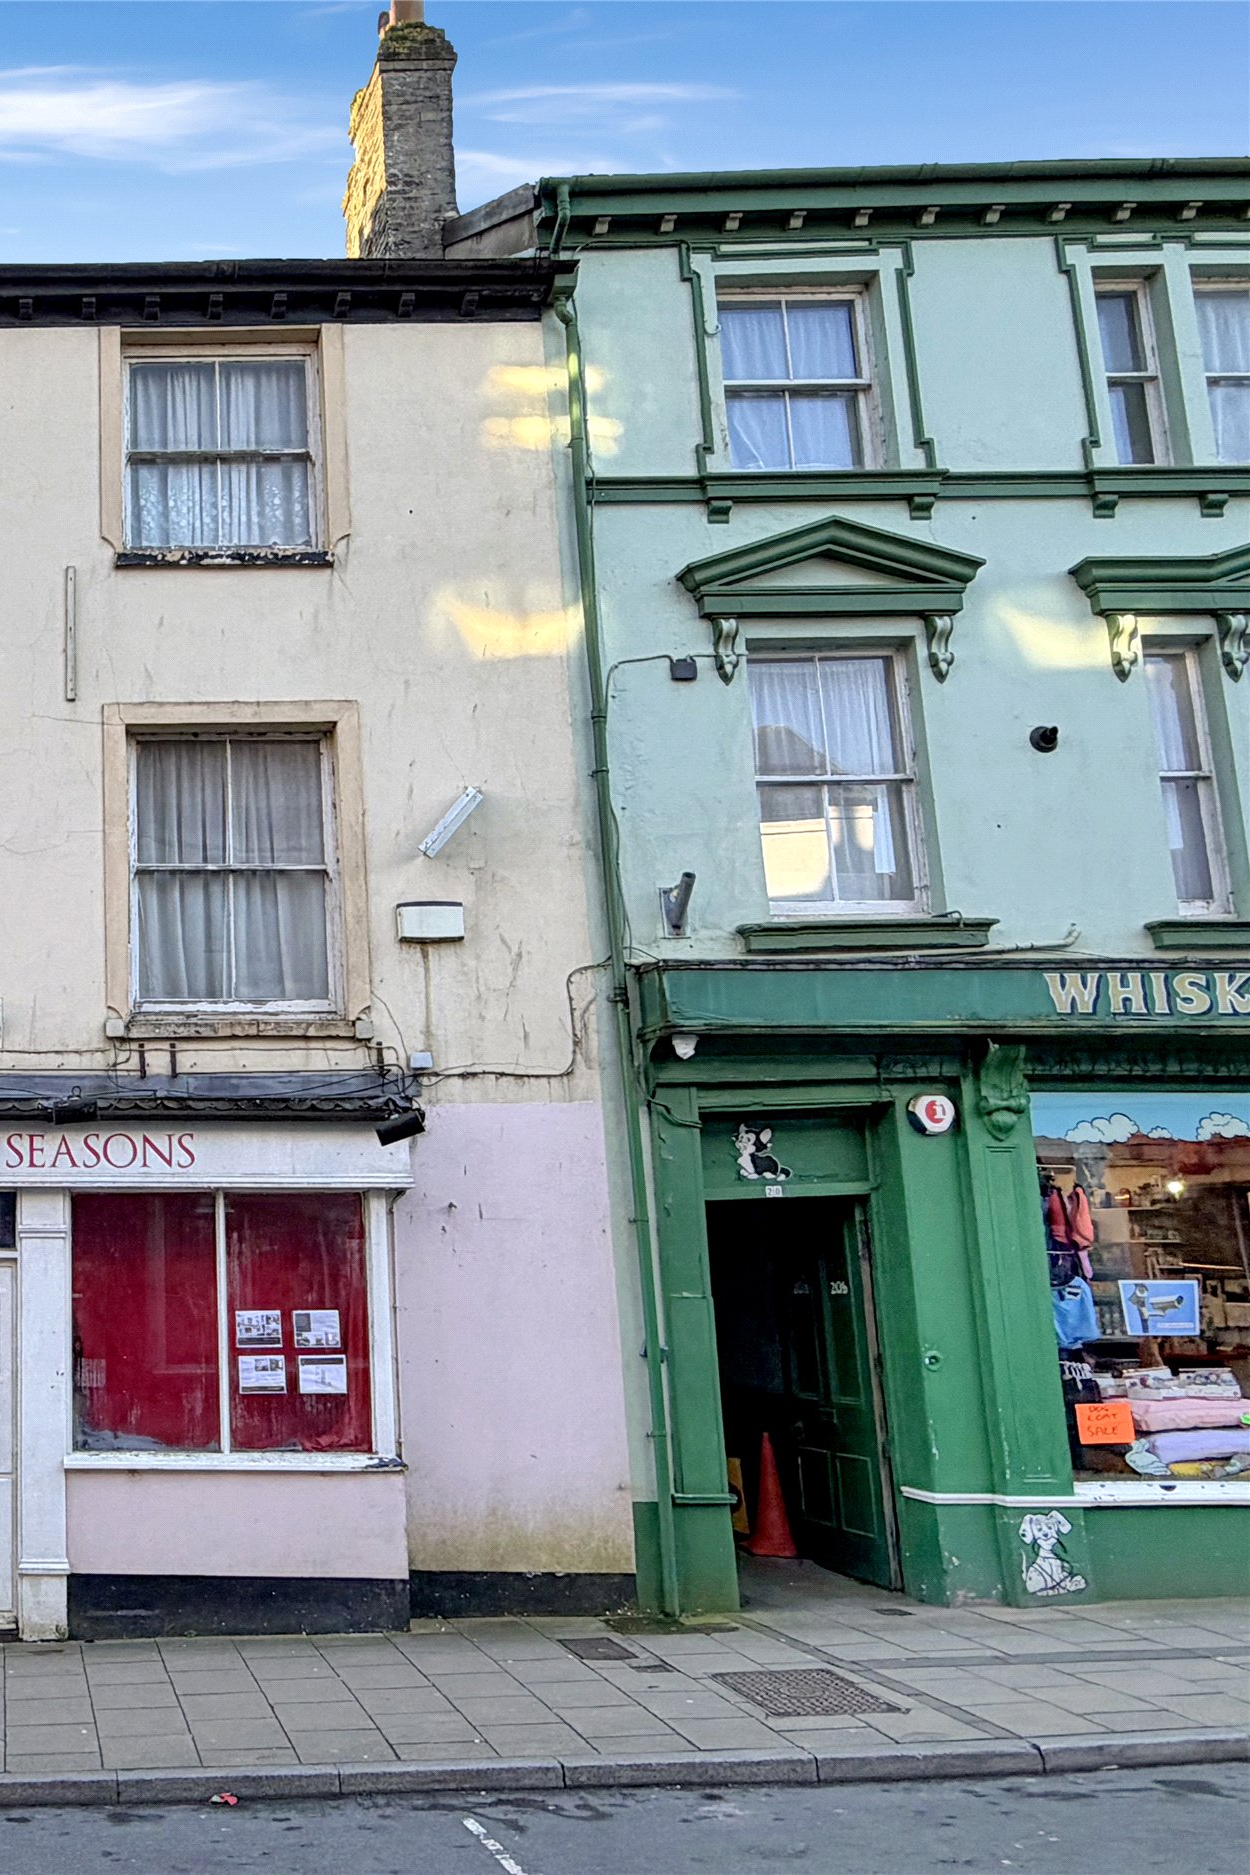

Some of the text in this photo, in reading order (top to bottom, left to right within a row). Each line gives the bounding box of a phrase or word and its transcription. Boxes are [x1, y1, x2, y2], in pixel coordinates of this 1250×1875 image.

[1043, 972, 1250, 1015] WHISK
[6, 1133, 196, 1168] SEASONS
[1087, 1426, 1118, 1436] SALE
